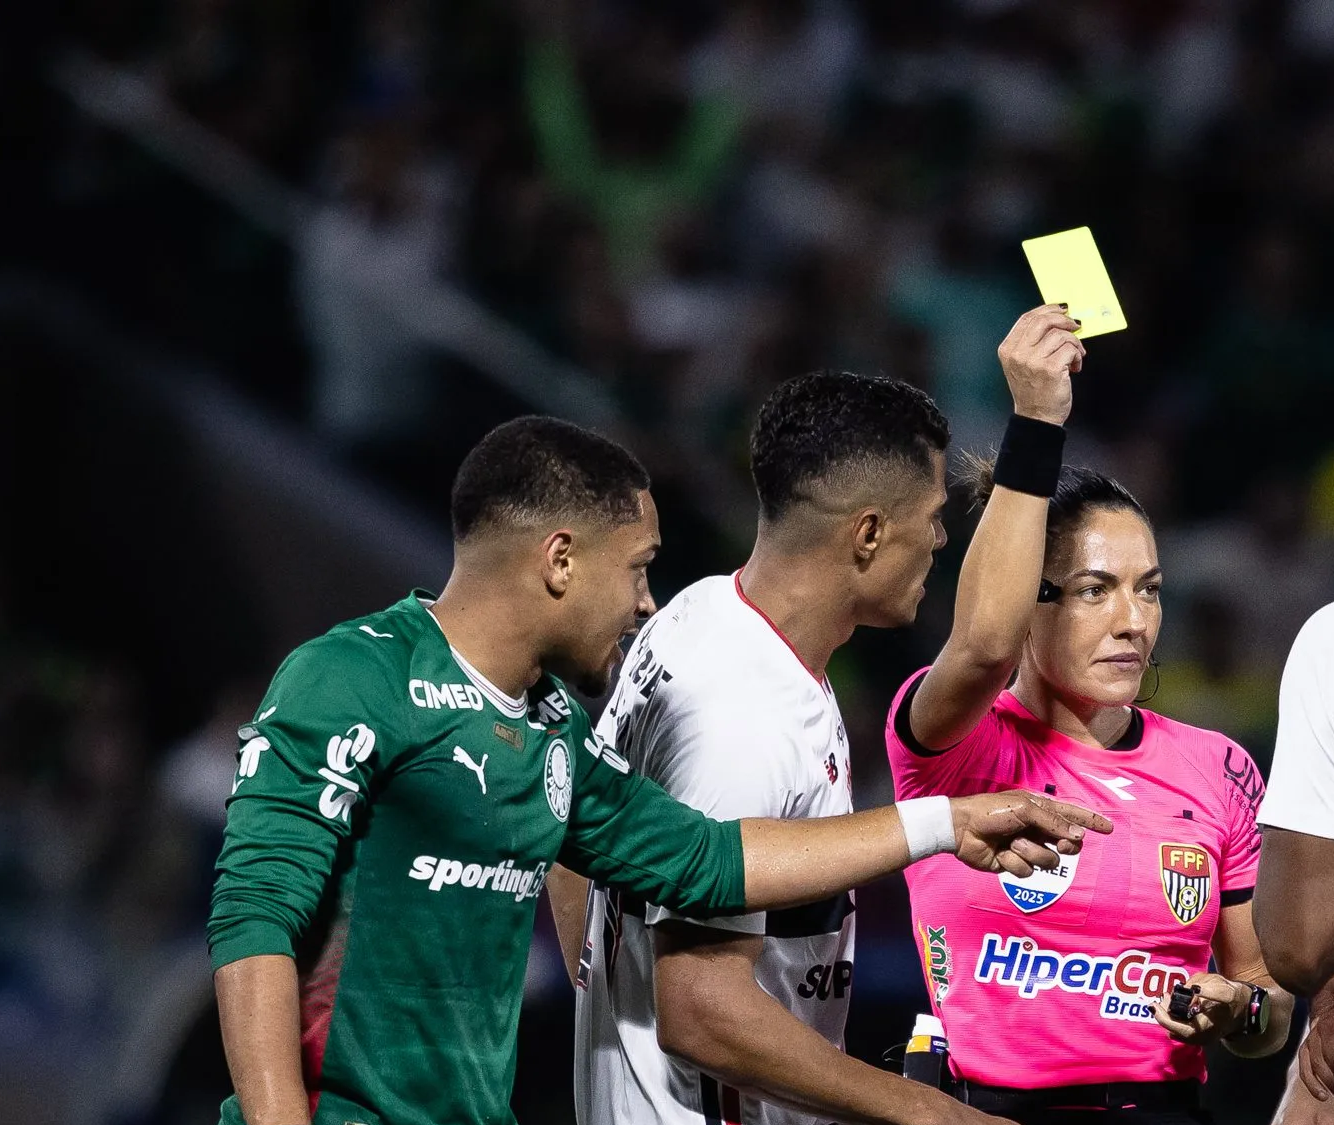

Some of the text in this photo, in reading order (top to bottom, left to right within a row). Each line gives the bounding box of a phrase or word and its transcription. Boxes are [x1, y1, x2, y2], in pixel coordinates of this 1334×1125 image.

[409, 679, 484, 711] CIMED
[1169, 850, 1204, 871] FPF
[1013, 888, 1045, 904] 2025
